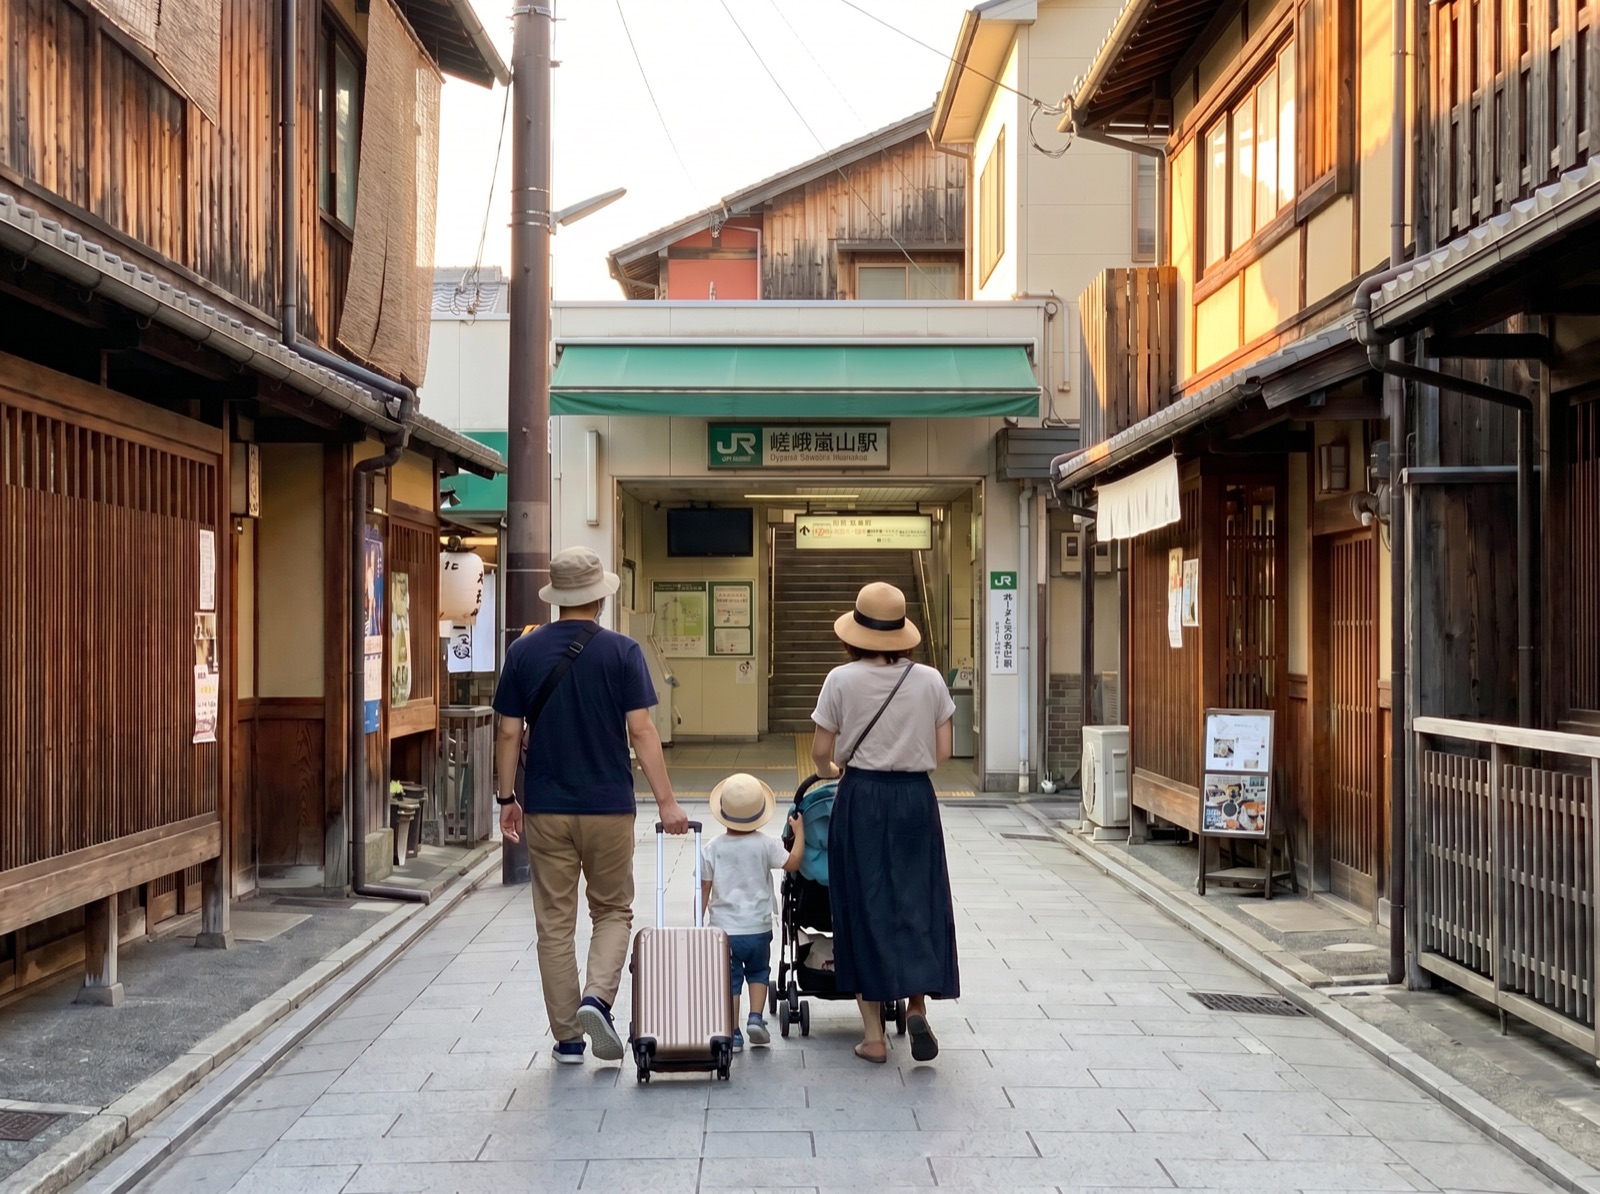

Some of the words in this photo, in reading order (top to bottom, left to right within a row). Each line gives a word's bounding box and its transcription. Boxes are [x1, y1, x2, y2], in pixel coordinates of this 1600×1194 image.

[716, 432, 756, 455] JR
[770, 432, 878, 452] 嵯峨嵐山駅
[994, 575, 1011, 586] JR
